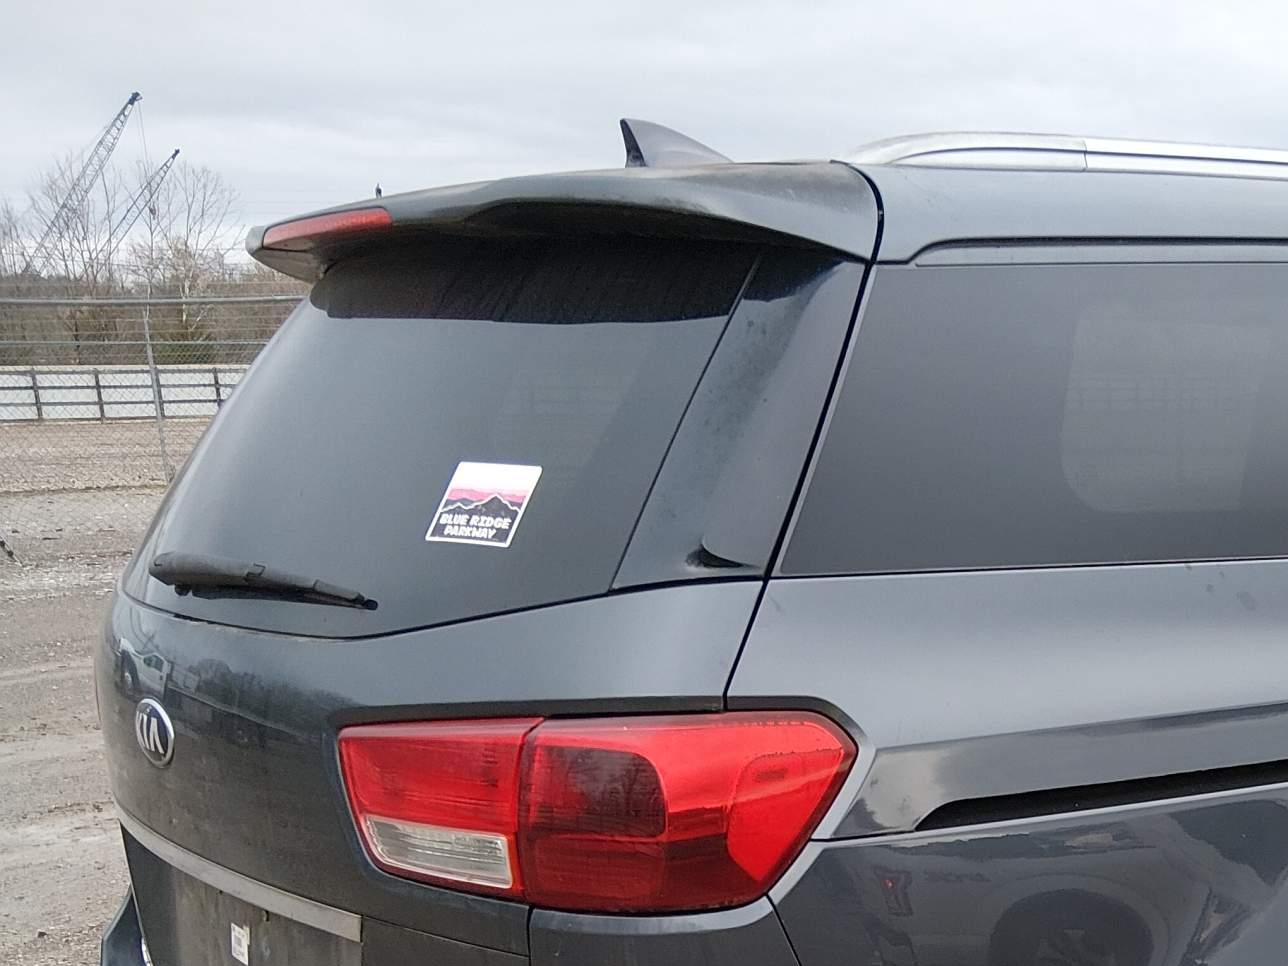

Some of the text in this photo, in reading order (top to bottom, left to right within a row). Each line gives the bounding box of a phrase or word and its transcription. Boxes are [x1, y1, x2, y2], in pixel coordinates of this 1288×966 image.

[440, 513, 512, 529] BLUE RIDGE
[444, 525, 497, 538] PARKWAY
